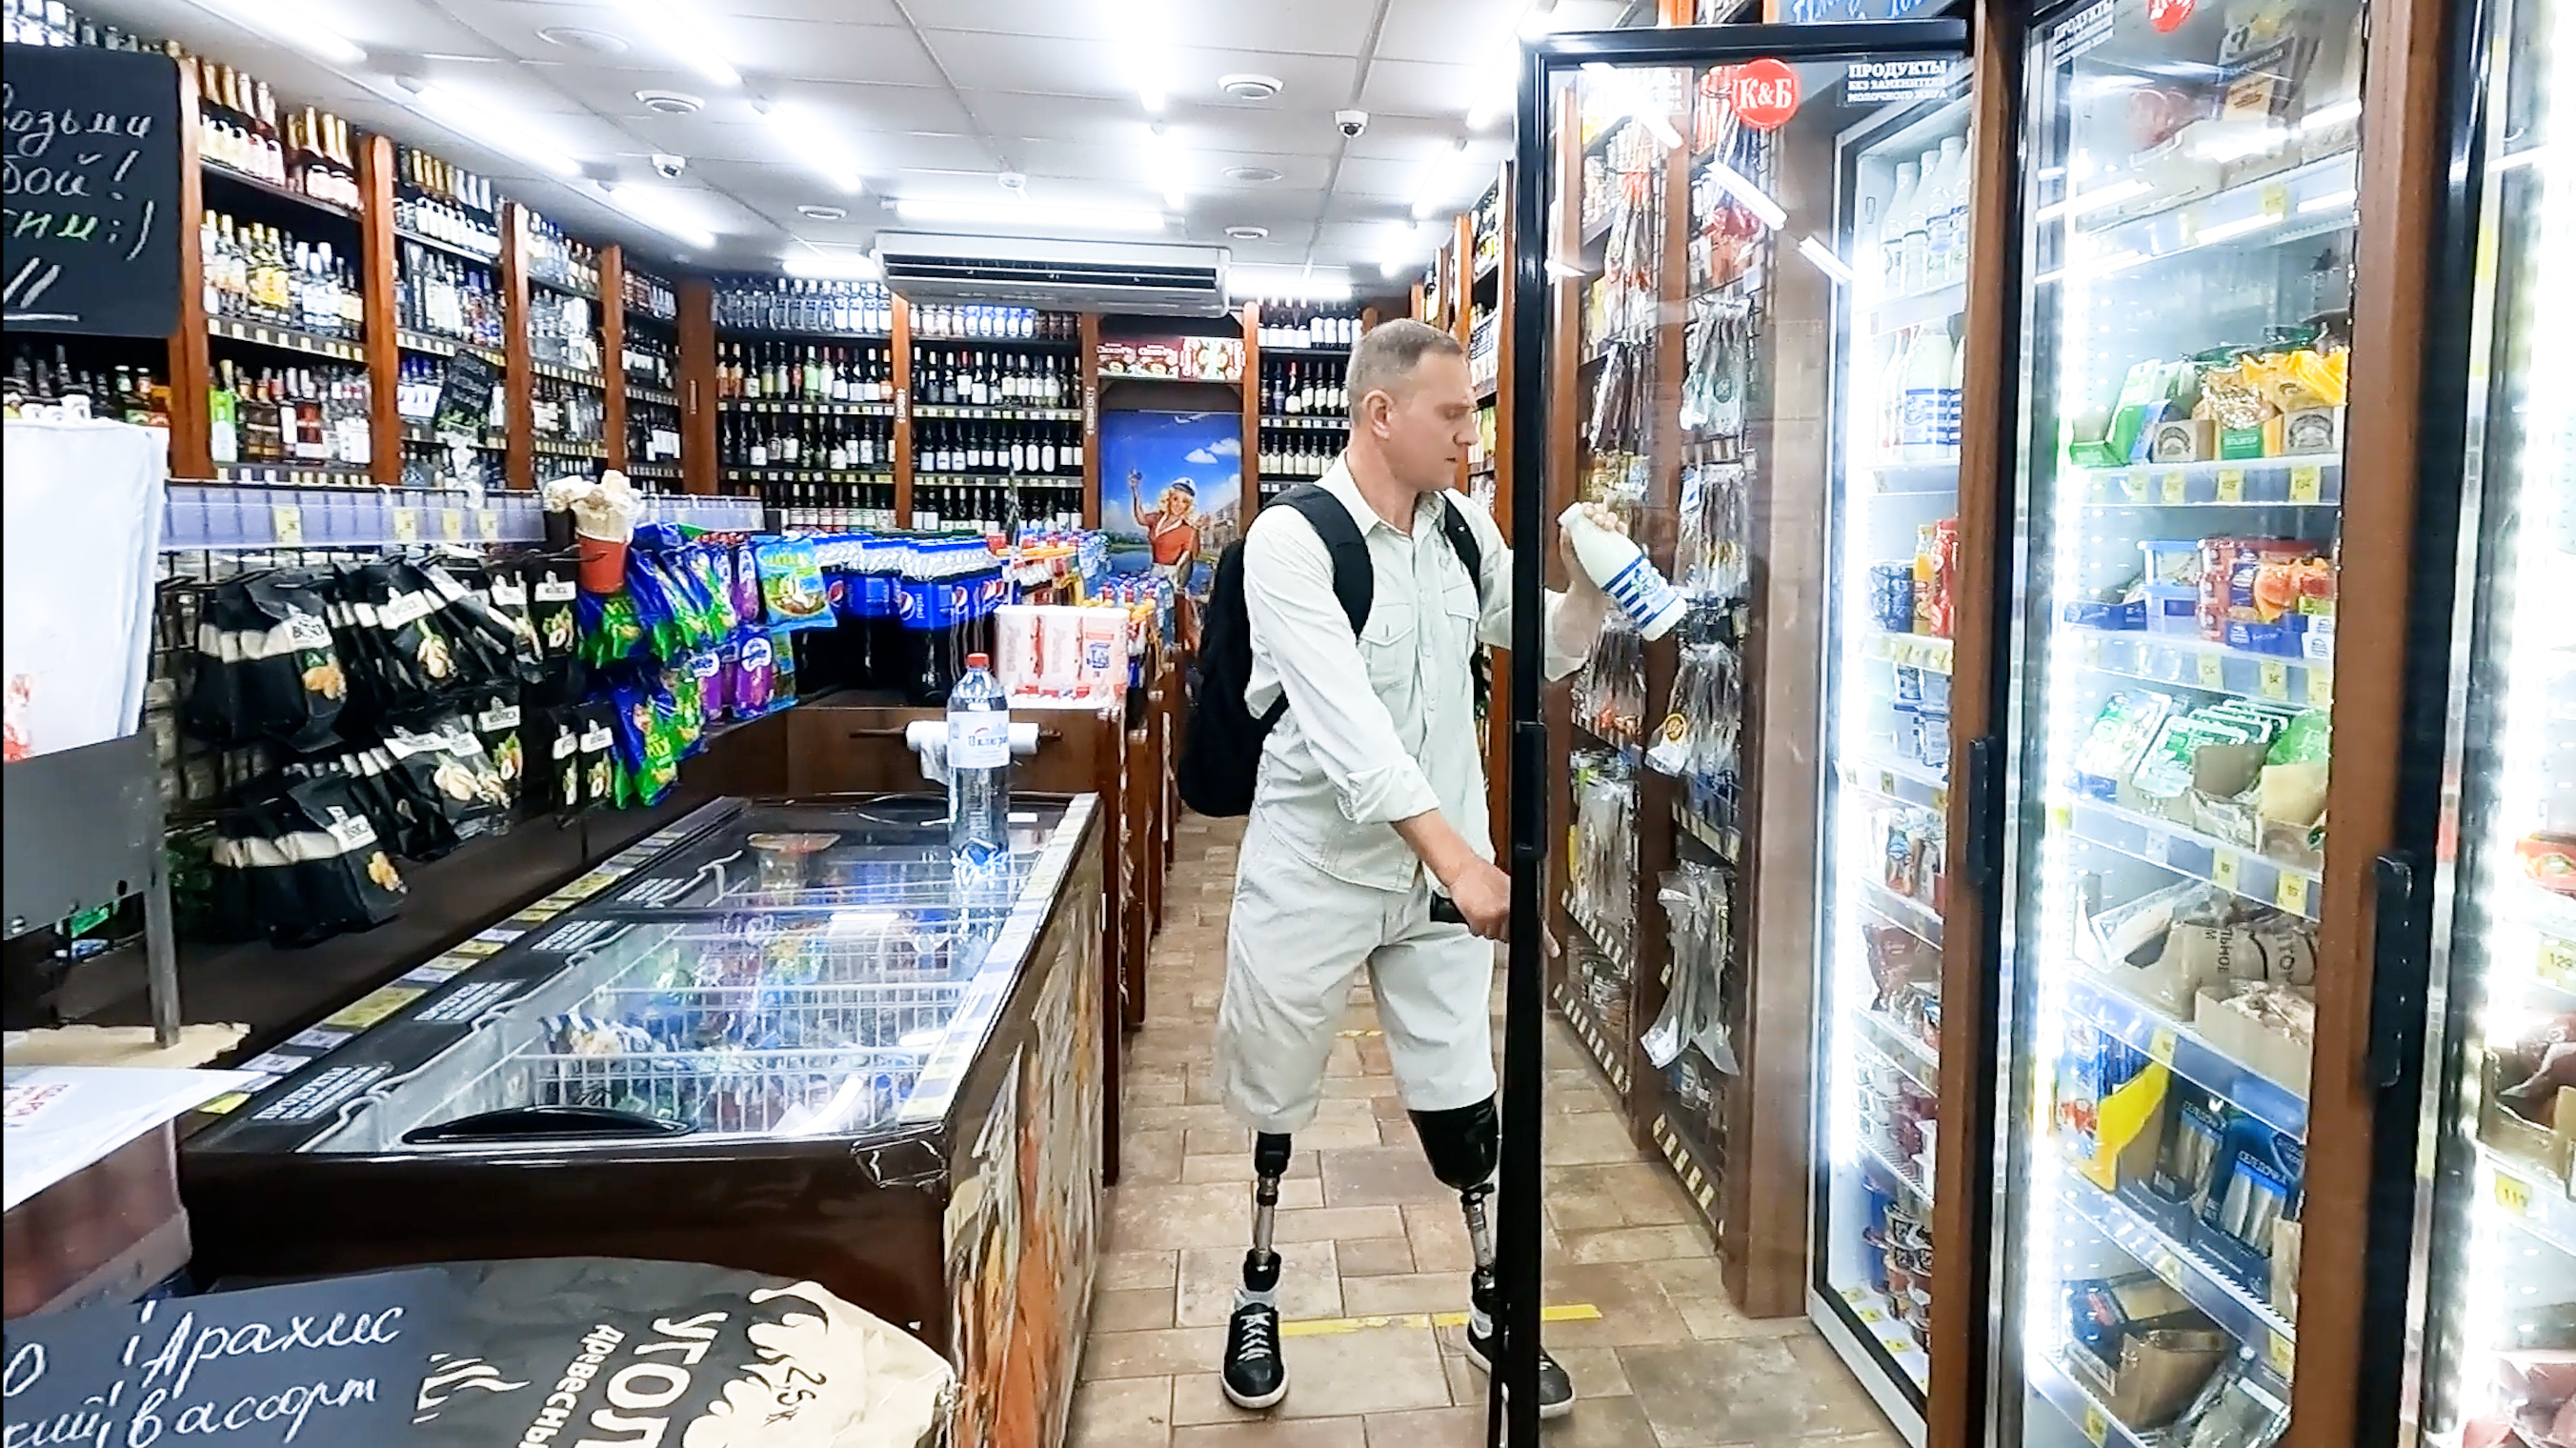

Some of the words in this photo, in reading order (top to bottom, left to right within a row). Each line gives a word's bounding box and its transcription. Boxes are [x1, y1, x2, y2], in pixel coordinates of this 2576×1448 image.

[1848, 60, 1948, 78] ПРОДУКТЫ
[1739, 78, 1793, 111] К&Б
[139, 1306, 404, 1400] Арахис
